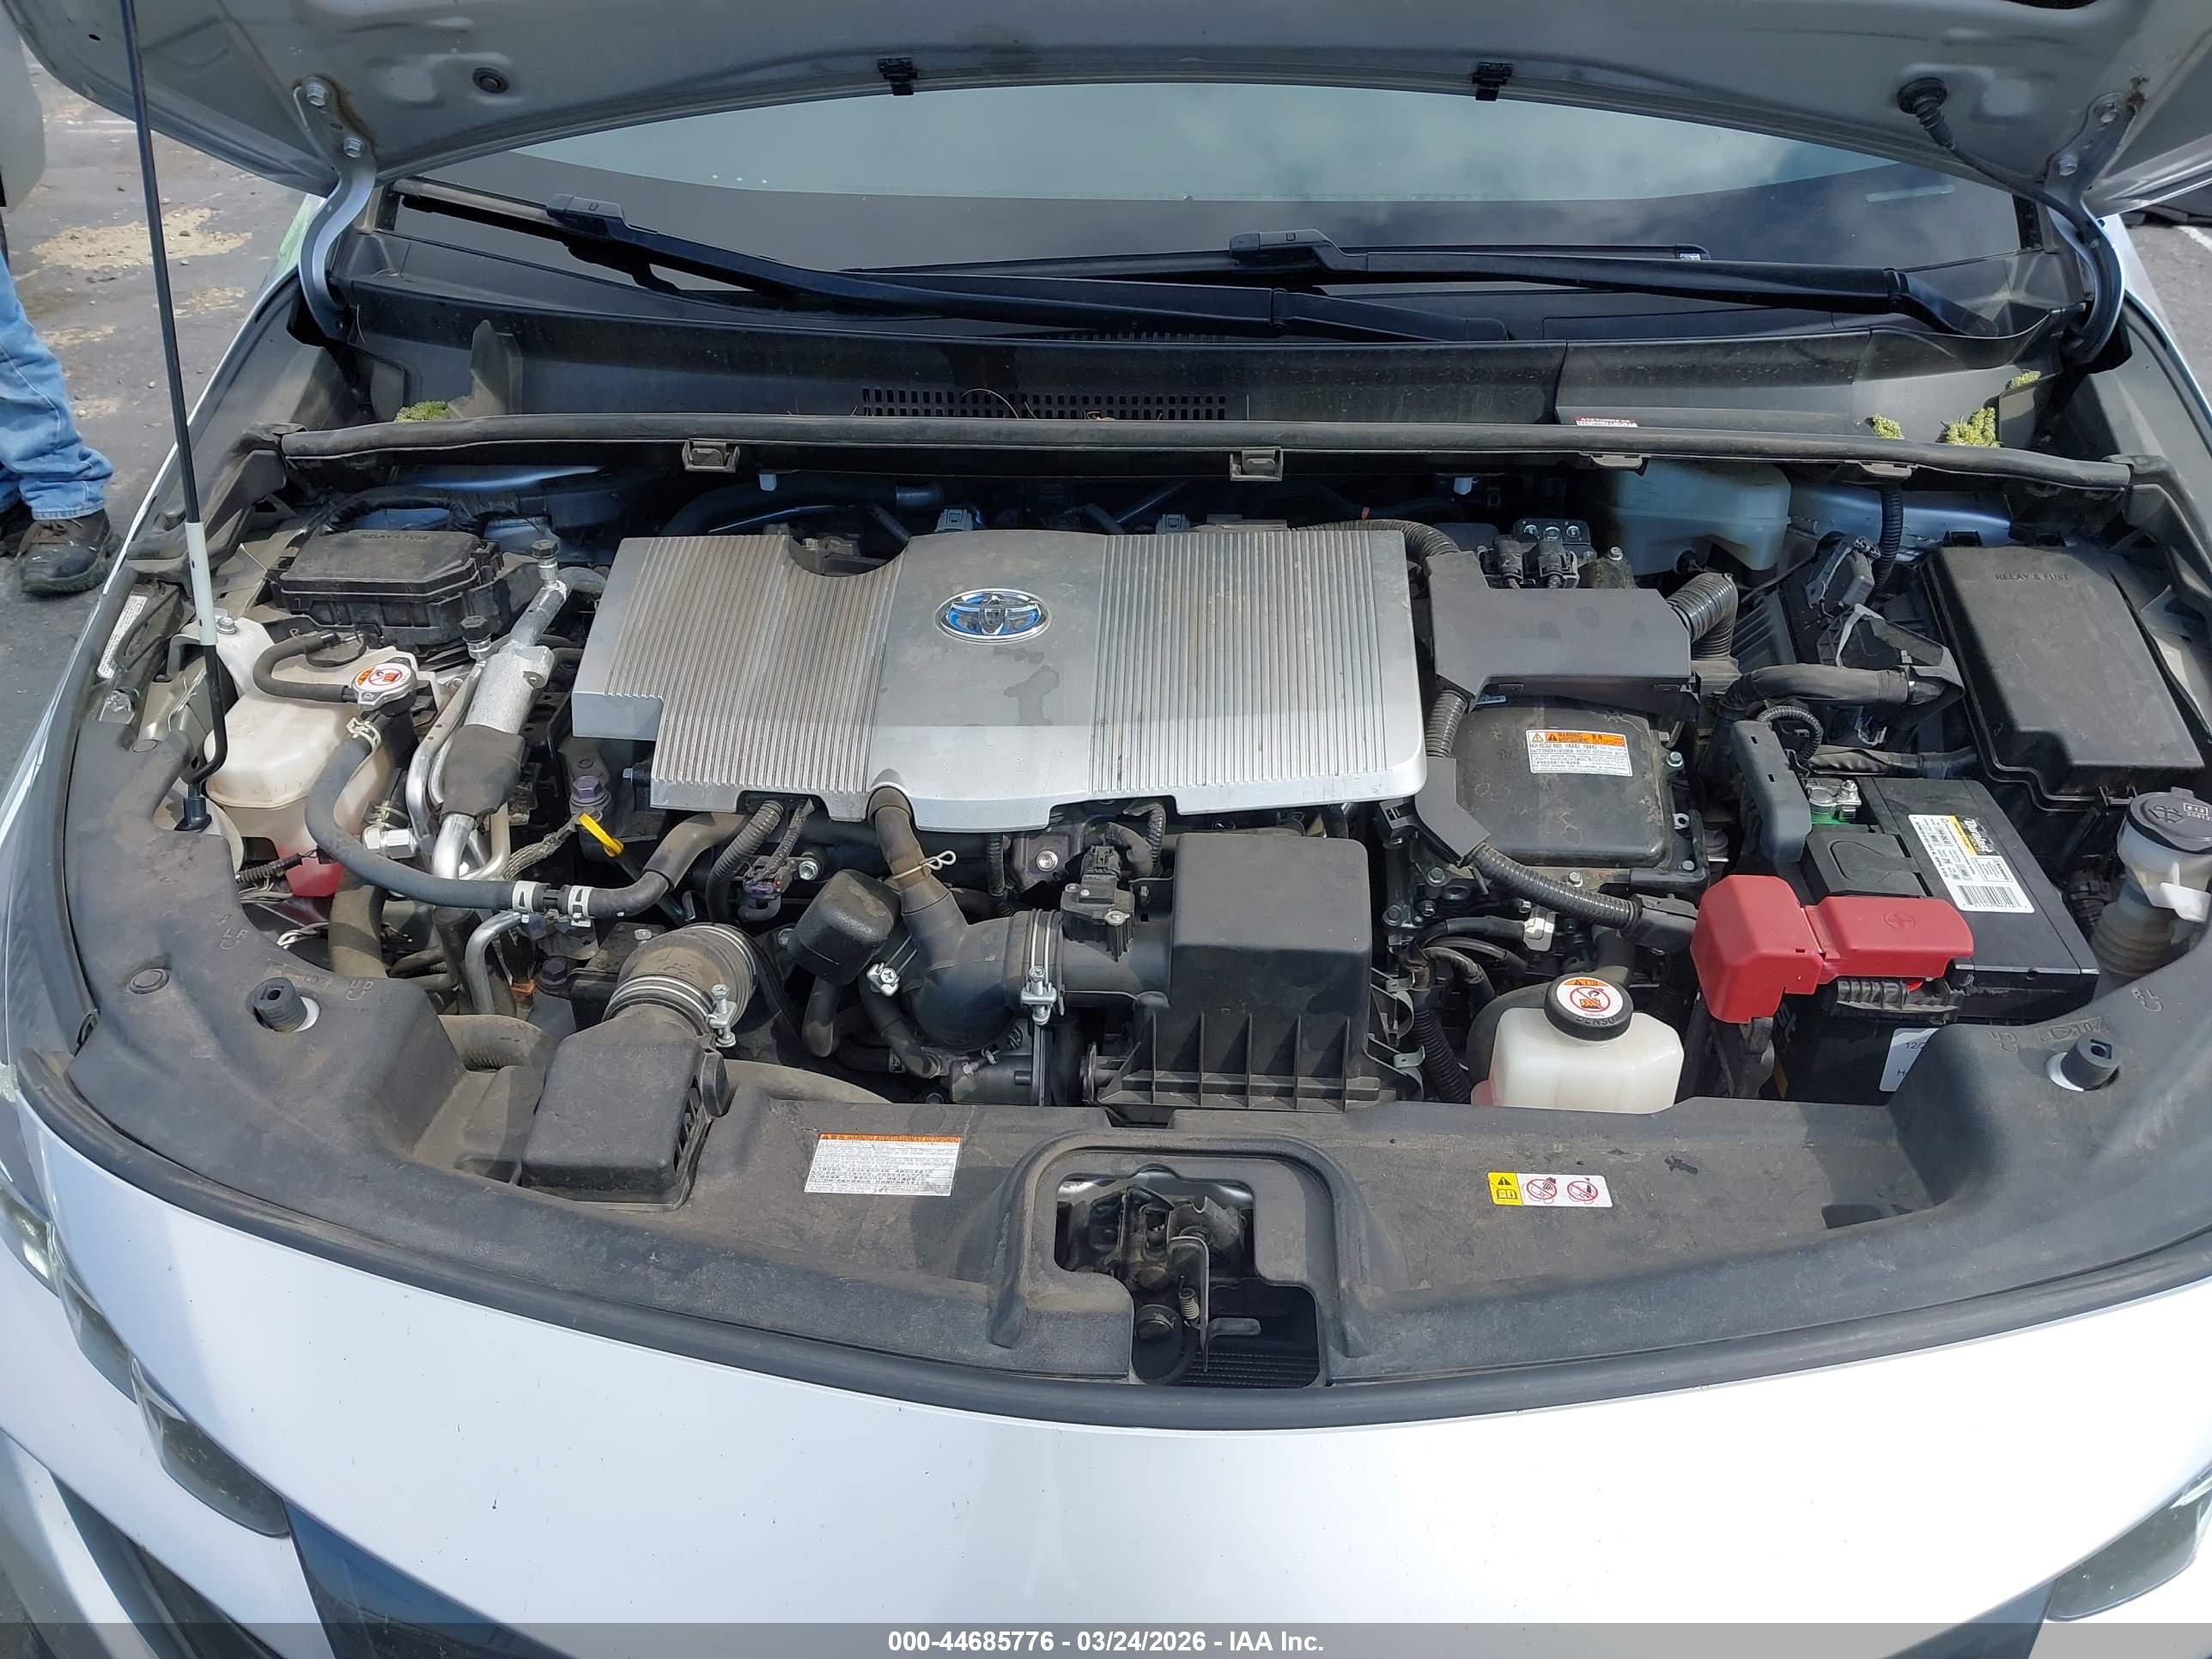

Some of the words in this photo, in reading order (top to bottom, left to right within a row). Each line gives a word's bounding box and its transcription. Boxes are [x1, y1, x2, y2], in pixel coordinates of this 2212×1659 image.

[2044, 573, 2070, 581] FUSE
[1963, 817, 1993, 854] Duralast
[1575, 1015, 1616, 1026] DENSO
